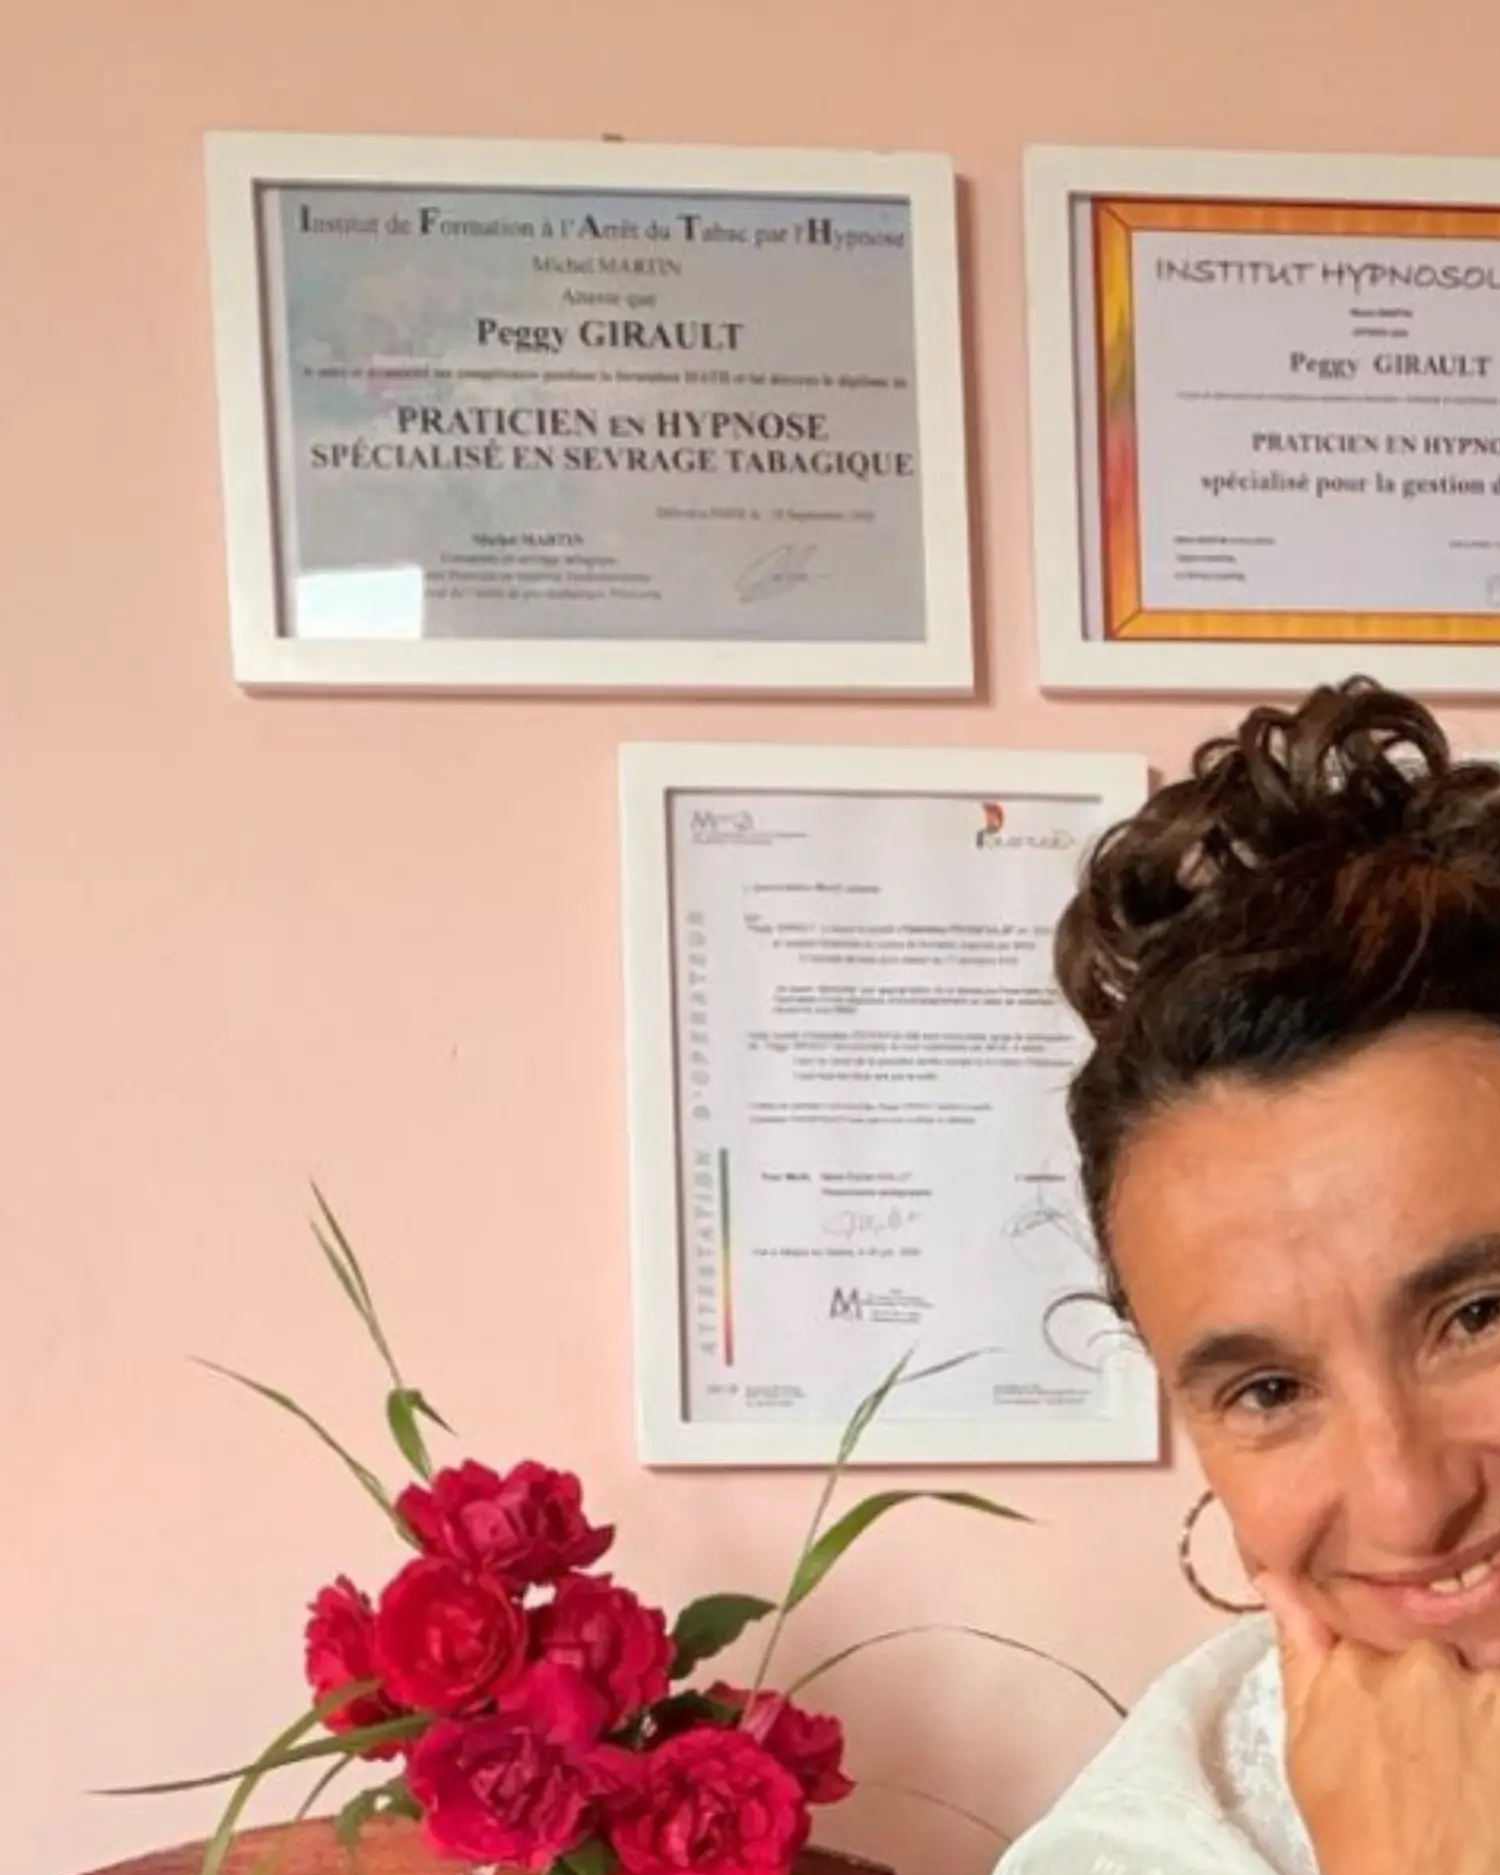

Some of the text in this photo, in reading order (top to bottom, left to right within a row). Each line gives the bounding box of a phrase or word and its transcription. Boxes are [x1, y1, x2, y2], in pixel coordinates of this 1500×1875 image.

[383, 212, 412, 236] de
[419, 206, 536, 238] Formation
[644, 219, 671, 241] du
[755, 225, 790, 249] par
[598, 257, 682, 276] MARTIN
[1155, 258, 1316, 286] INSTITUT
[478, 318, 744, 353] Peggy GIRAULT
[1290, 352, 1492, 381] Peggy GIRAULT
[397, 405, 829, 441] PRATICIEN EN HYPNOSE
[310, 436, 914, 481] SPÉCIALISÉ EN SEVRAGE TABAGIQUE
[1252, 432, 1379, 455] PRATICIEN
[1385, 434, 1418, 455] EN
[1200, 470, 1310, 497] spécialisé
[1316, 476, 1369, 499] pour
[1375, 472, 1397, 495] la
[1401, 476, 1486, 500] gestion
